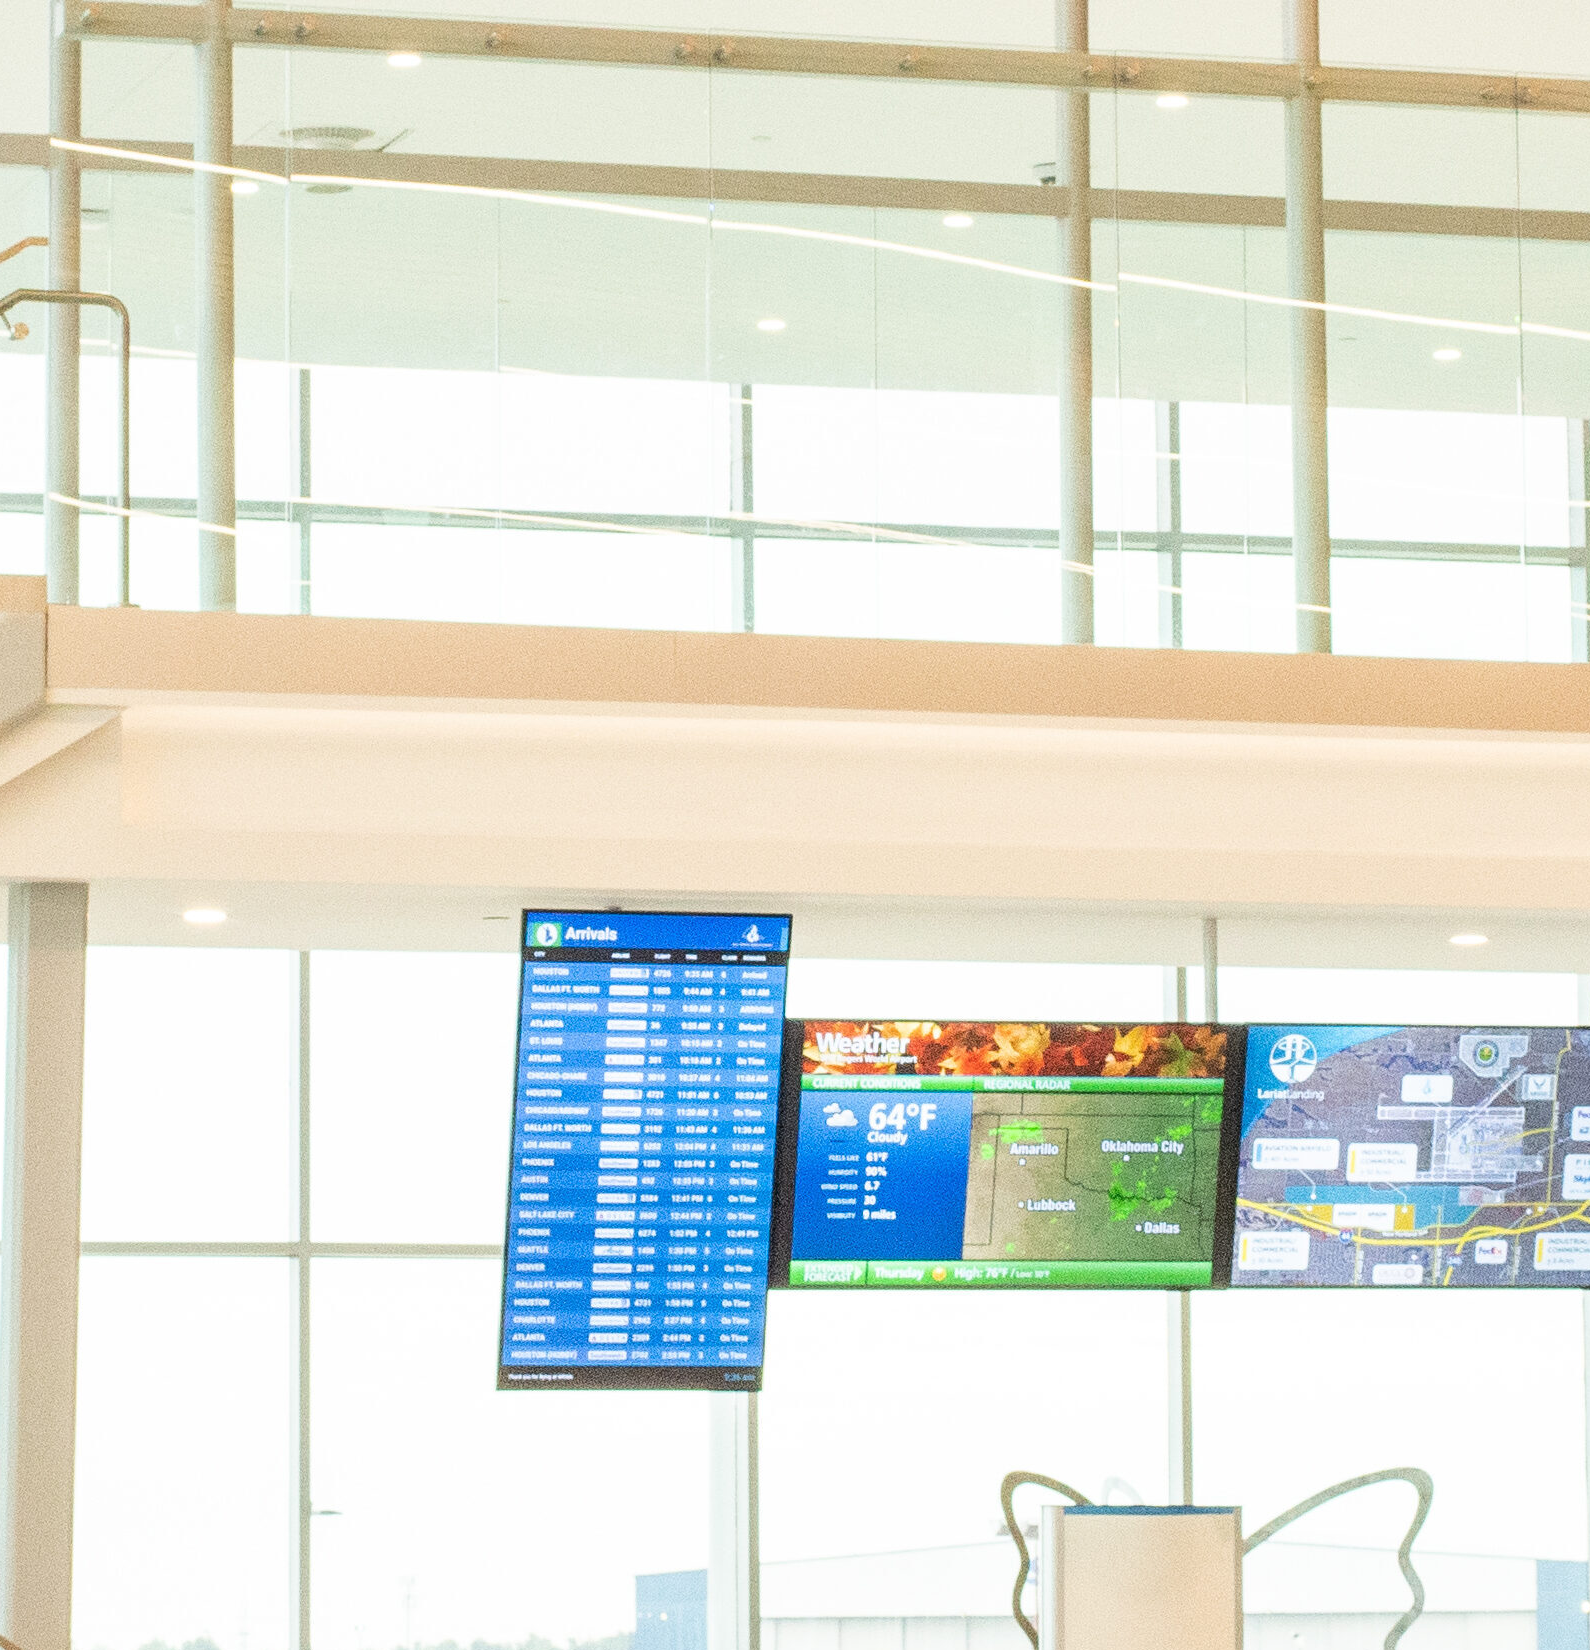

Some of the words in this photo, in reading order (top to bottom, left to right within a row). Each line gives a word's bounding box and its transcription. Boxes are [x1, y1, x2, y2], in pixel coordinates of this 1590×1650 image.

[565, 926, 618, 941] Arrivals
[815, 1031, 911, 1054] Weather
[865, 1055, 888, 1063] World
[889, 1055, 918, 1065] Airport
[812, 1077, 858, 1089] CURRENT
[860, 1078, 922, 1090] CONDITIONS
[983, 1079, 1033, 1090] REGIONAL
[1035, 1079, 1071, 1090] RADAR
[868, 1102, 937, 1131] 64°F
[867, 1130, 909, 1146] Cloudy
[1009, 1142, 1059, 1156] Amarillo
[1100, 1139, 1159, 1153] Oklahoma
[1160, 1140, 1185, 1156] City
[865, 1166, 887, 1177] 90%
[864, 1180, 881, 1191] 6.7
[1026, 1198, 1076, 1212] Lubbock
[870, 1209, 897, 1220] miles
[1143, 1221, 1181, 1235] Dallas
[874, 1265, 925, 1281] Thursday
[954, 1265, 983, 1281] High:
